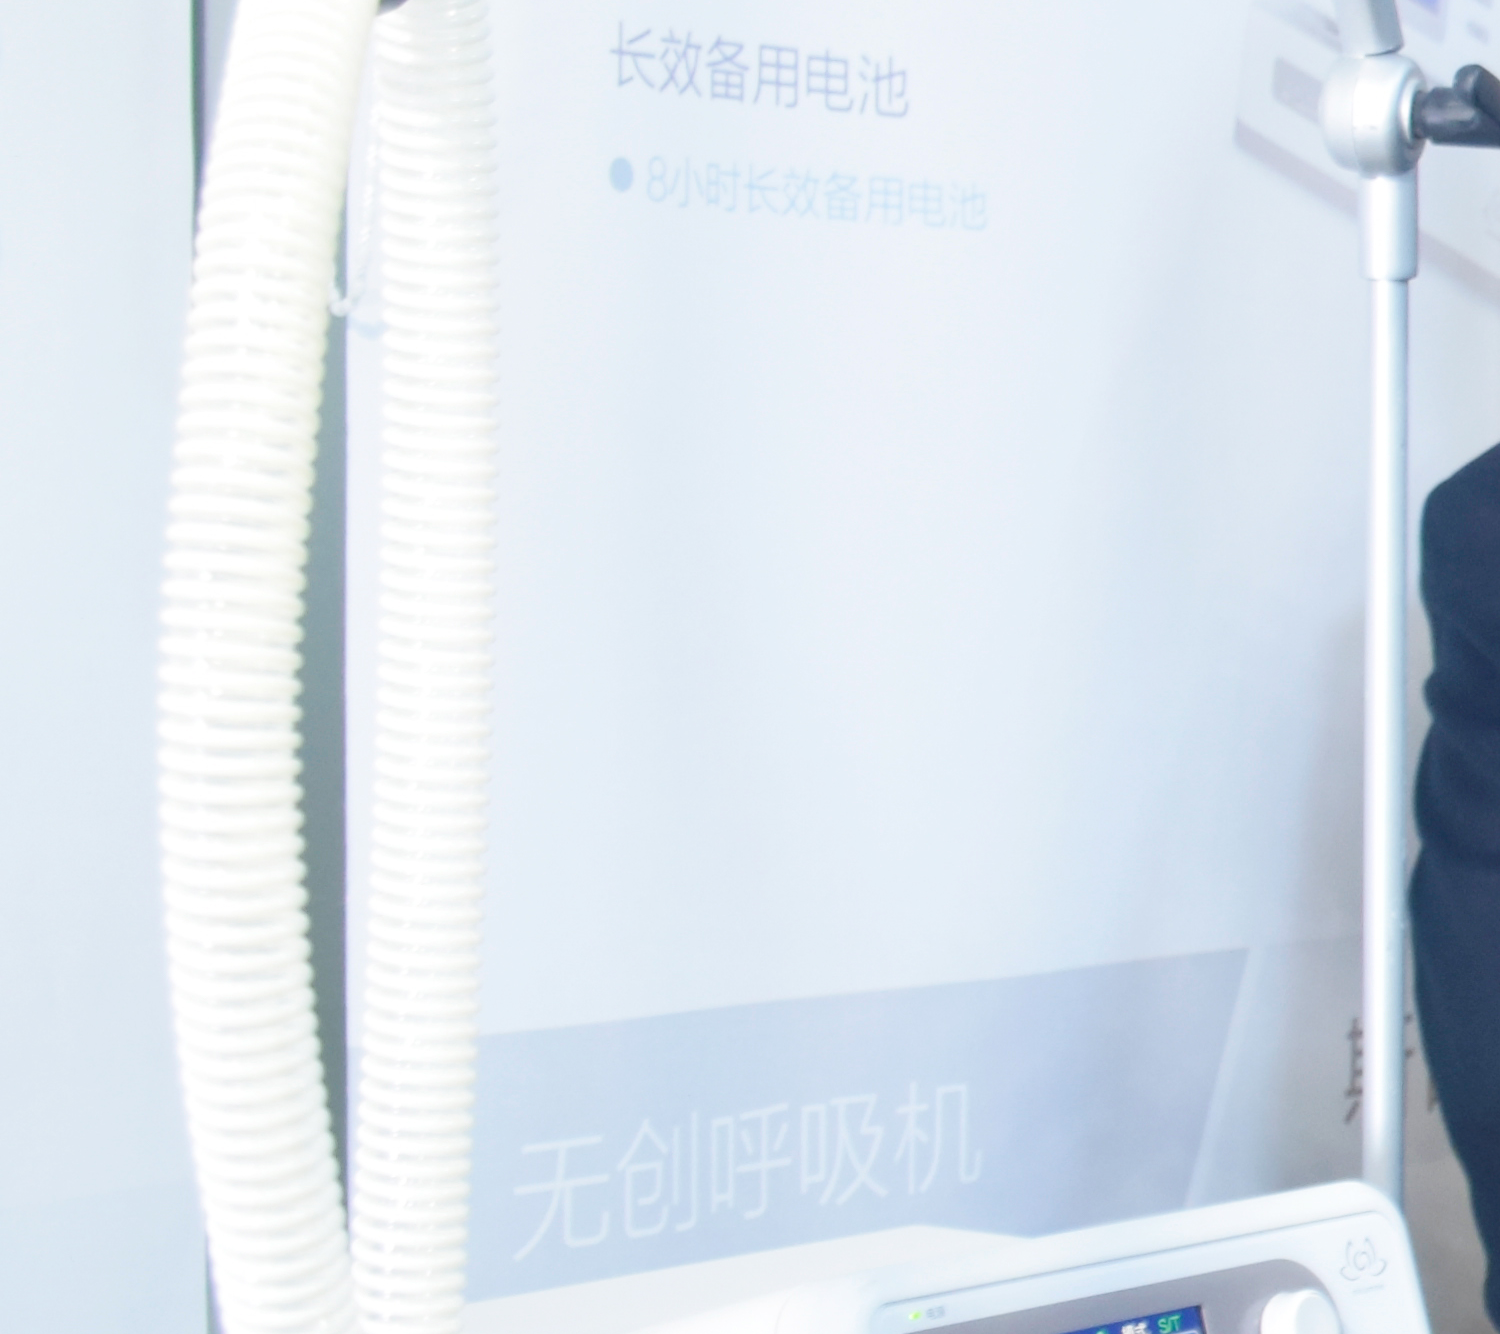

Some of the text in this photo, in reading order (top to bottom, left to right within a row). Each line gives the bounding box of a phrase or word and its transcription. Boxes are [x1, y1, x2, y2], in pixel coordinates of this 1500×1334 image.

[609, 20, 910, 119] 长效备用电池
[645, 155, 989, 232] 8小时长效备用电池
[512, 1081, 981, 1261] 无创呼吸机
